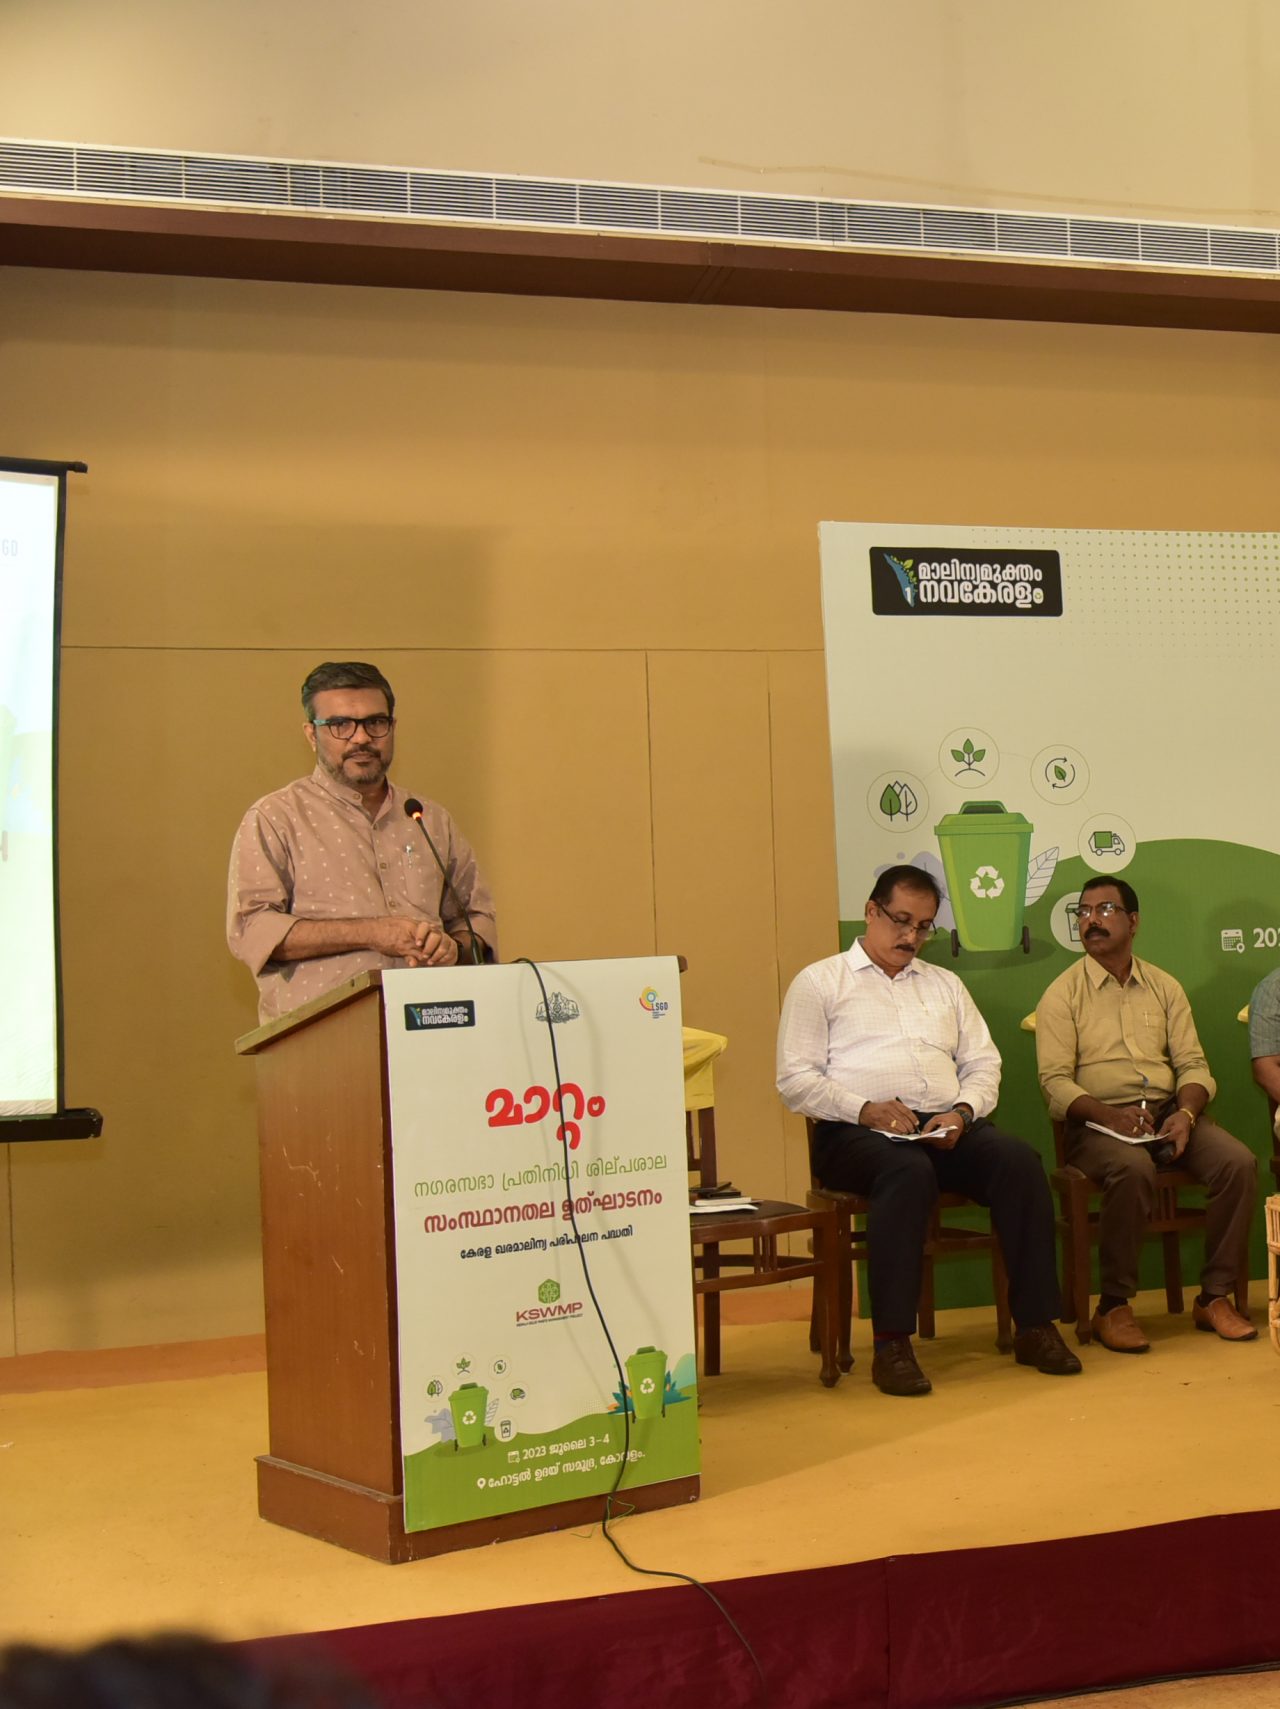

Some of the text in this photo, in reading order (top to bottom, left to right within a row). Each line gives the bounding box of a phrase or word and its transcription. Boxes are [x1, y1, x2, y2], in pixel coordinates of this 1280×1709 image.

[918, 558, 1043, 584] മാലിന്യമുക്തം
[919, 580, 1044, 608] നവകേരളം
[485, 1083, 606, 1149] മാറ്റം
[414, 1174, 494, 1197] നഗരസഭാ
[502, 1160, 579, 1191] പ്രതിനിധി
[424, 1201, 555, 1233] സംസ്ഥാനതല
[460, 1247, 492, 1259] കേരള
[495, 1237, 547, 1255] ഖരമാലിന്യ
[601, 1225, 633, 1240] പദ്ധതി
[516, 1302, 583, 1322] KSWMP
[522, 1446, 546, 1460] 2023
[488, 1469, 531, 1488] ഹോട്ടൽ
[534, 1462, 560, 1482] ഉദയ്
